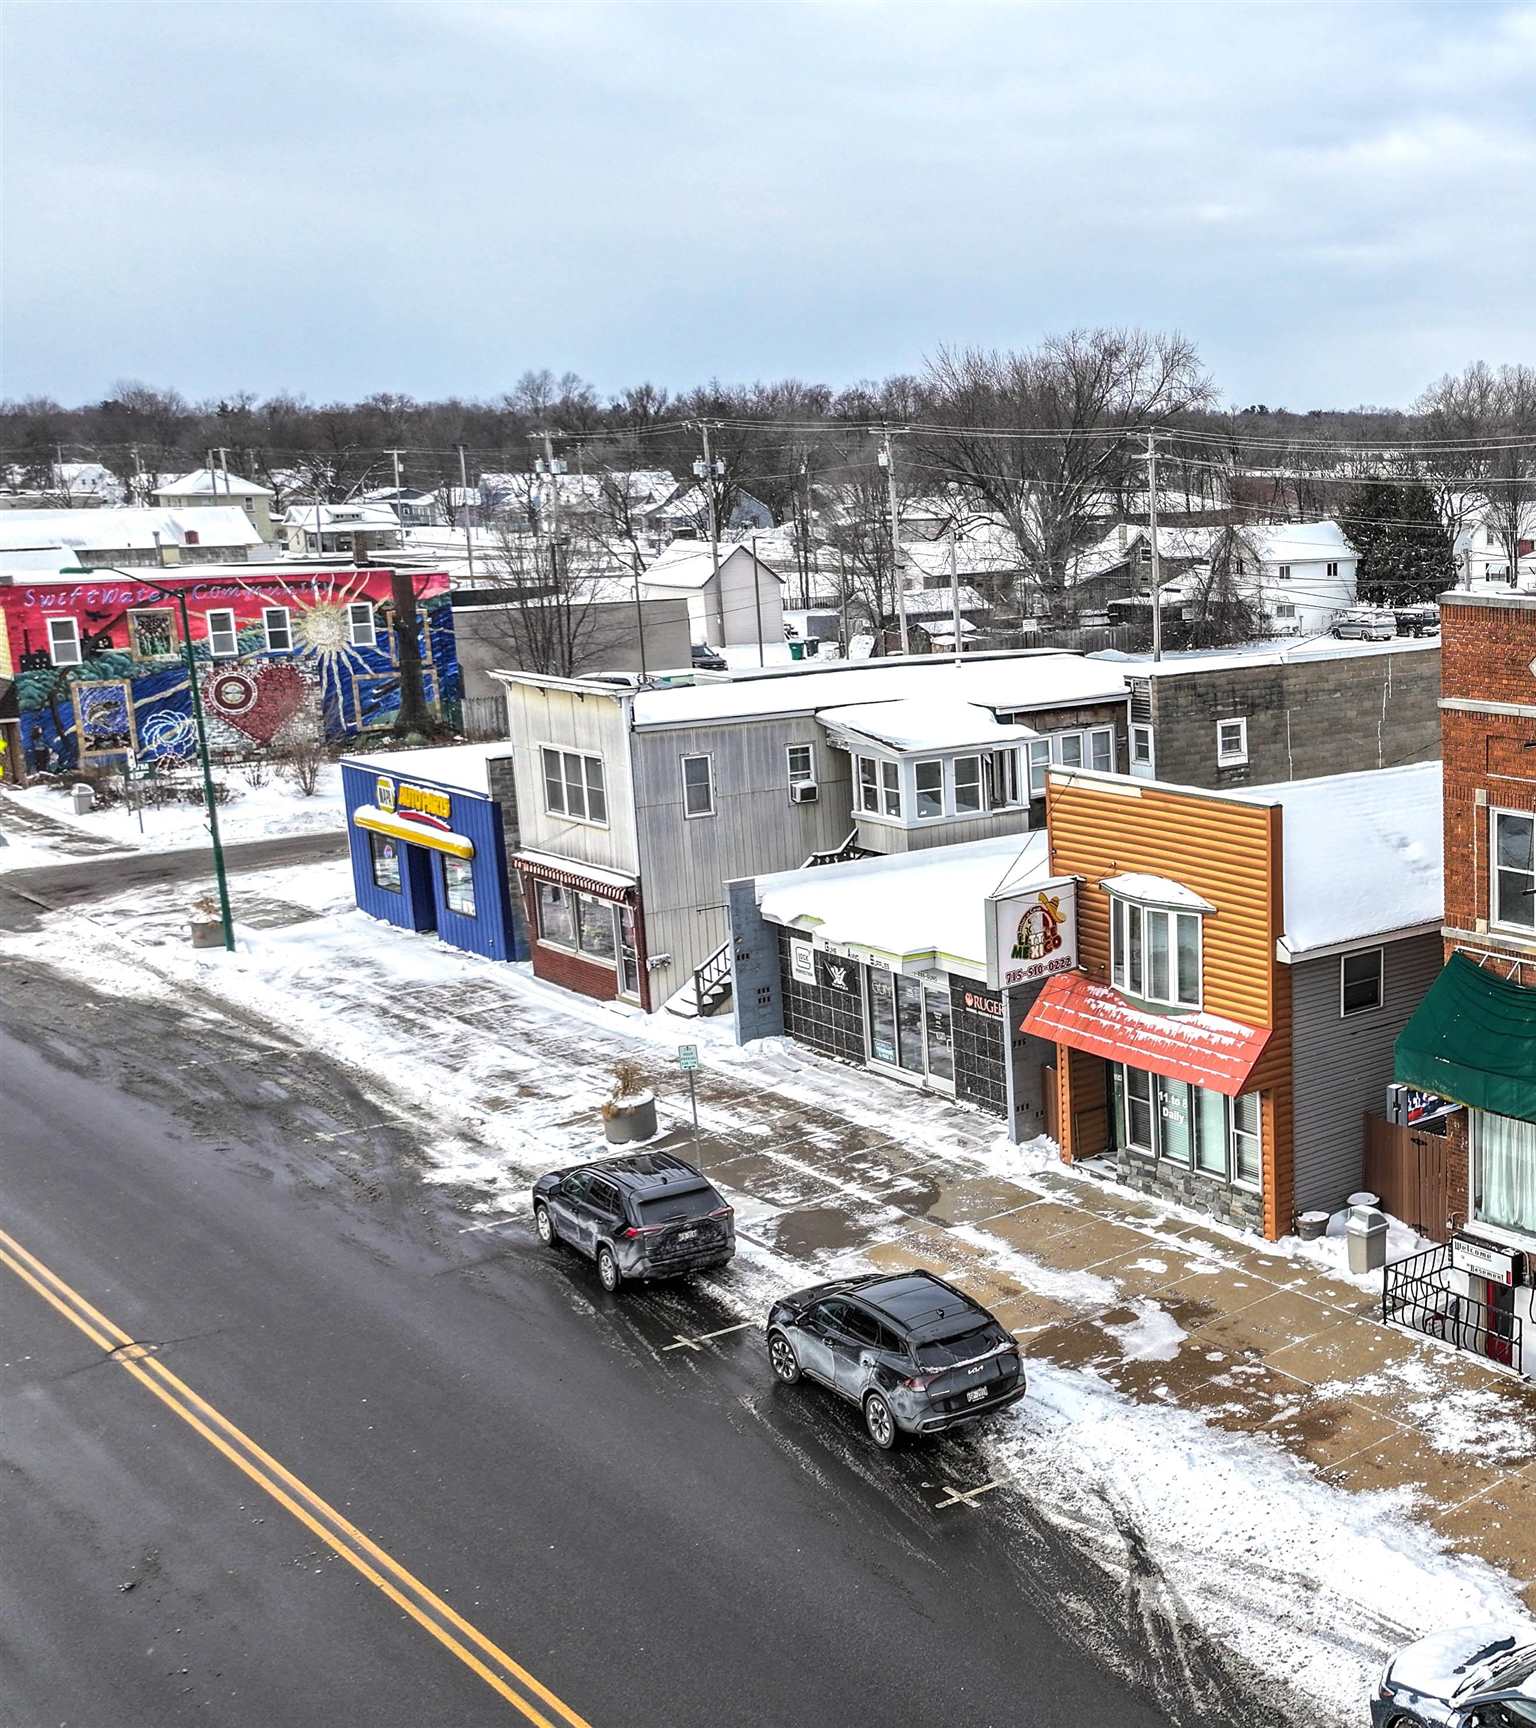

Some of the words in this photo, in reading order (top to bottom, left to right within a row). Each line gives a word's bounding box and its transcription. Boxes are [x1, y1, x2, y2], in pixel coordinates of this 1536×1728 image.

[1010, 934, 1062, 960] MEXICO
[1162, 1106, 1185, 1124] Daily
[1454, 1241, 1492, 1260] Welcome
